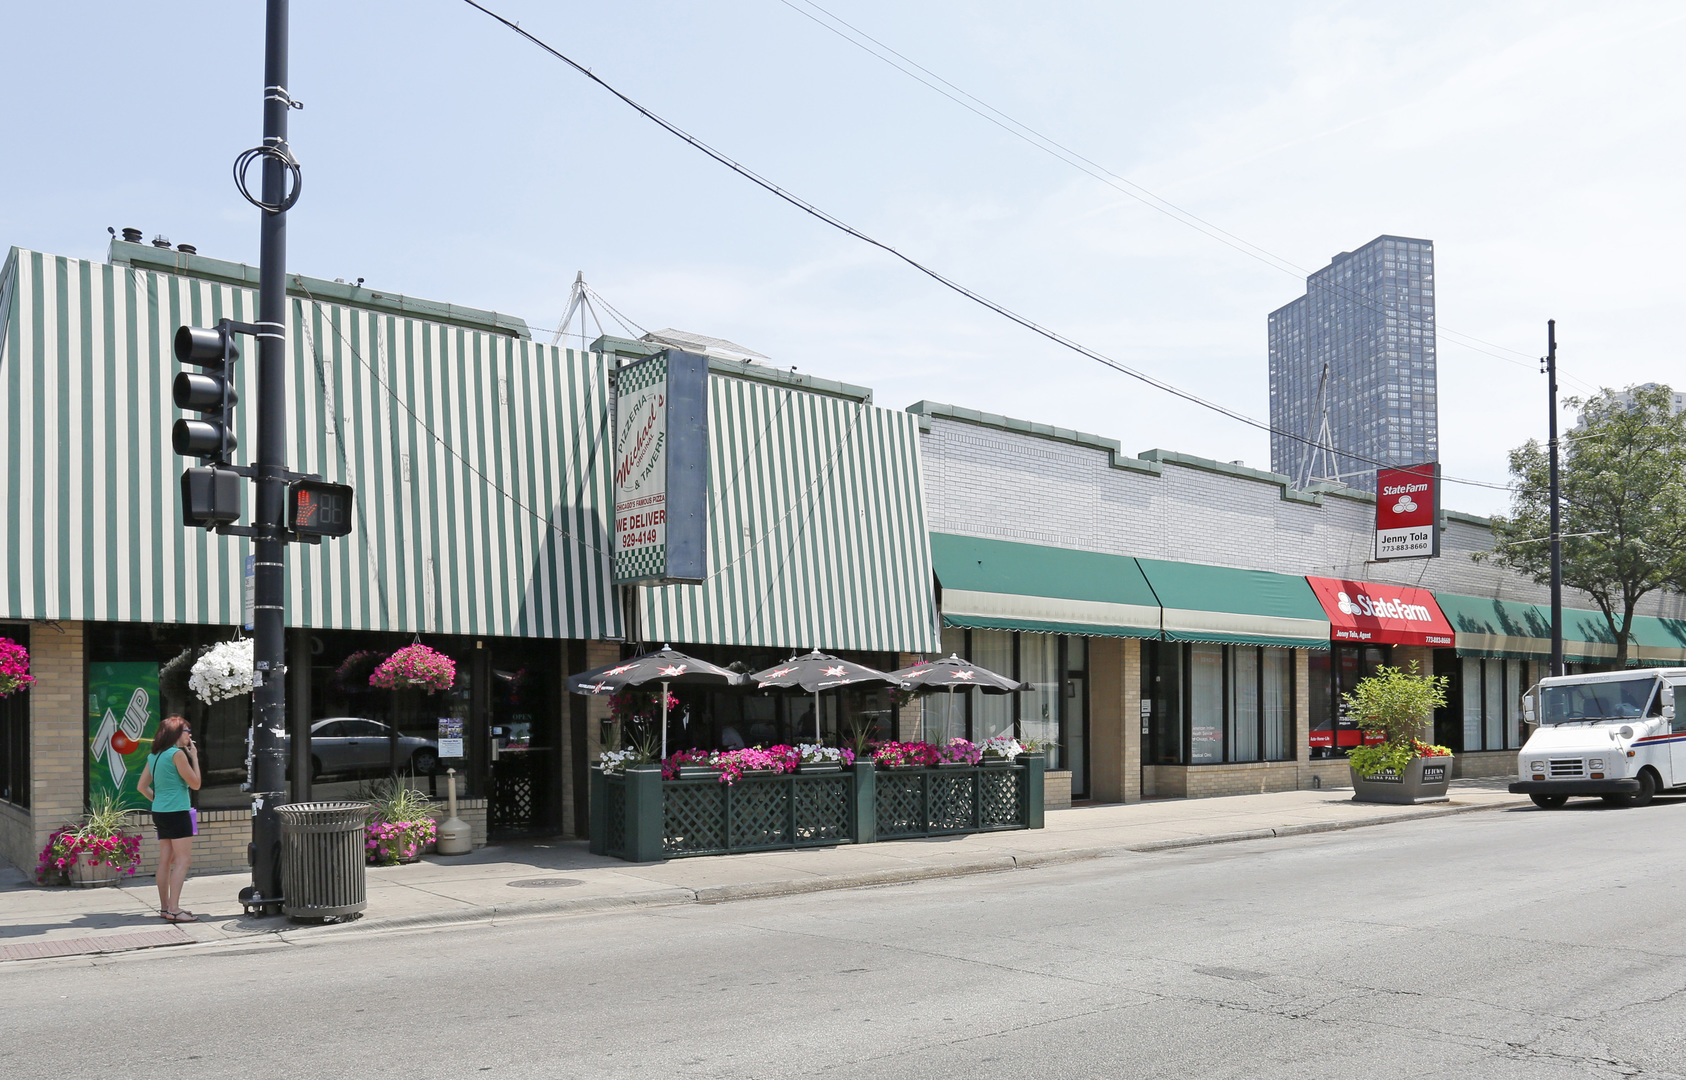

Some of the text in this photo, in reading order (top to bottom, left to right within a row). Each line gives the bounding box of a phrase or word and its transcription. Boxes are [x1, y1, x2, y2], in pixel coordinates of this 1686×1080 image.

[618, 394, 647, 453] PIZZERIA
[616, 394, 664, 488] Michael's
[636, 434, 655, 468] ORIGINAL
[634, 431, 665, 490] & TAVERN
[616, 494, 665, 511] CHICAGO'S FAMOUS PIZZA
[616, 509, 666, 533] WE DELIVER
[622, 528, 657, 548] 929-4149
[1381, 532, 1428, 544] Jenny Tola
[1382, 542, 1428, 552] 773-883-8660
[1336, 629, 1349, 639] Jenny
[1359, 631, 1372, 640] Agent
